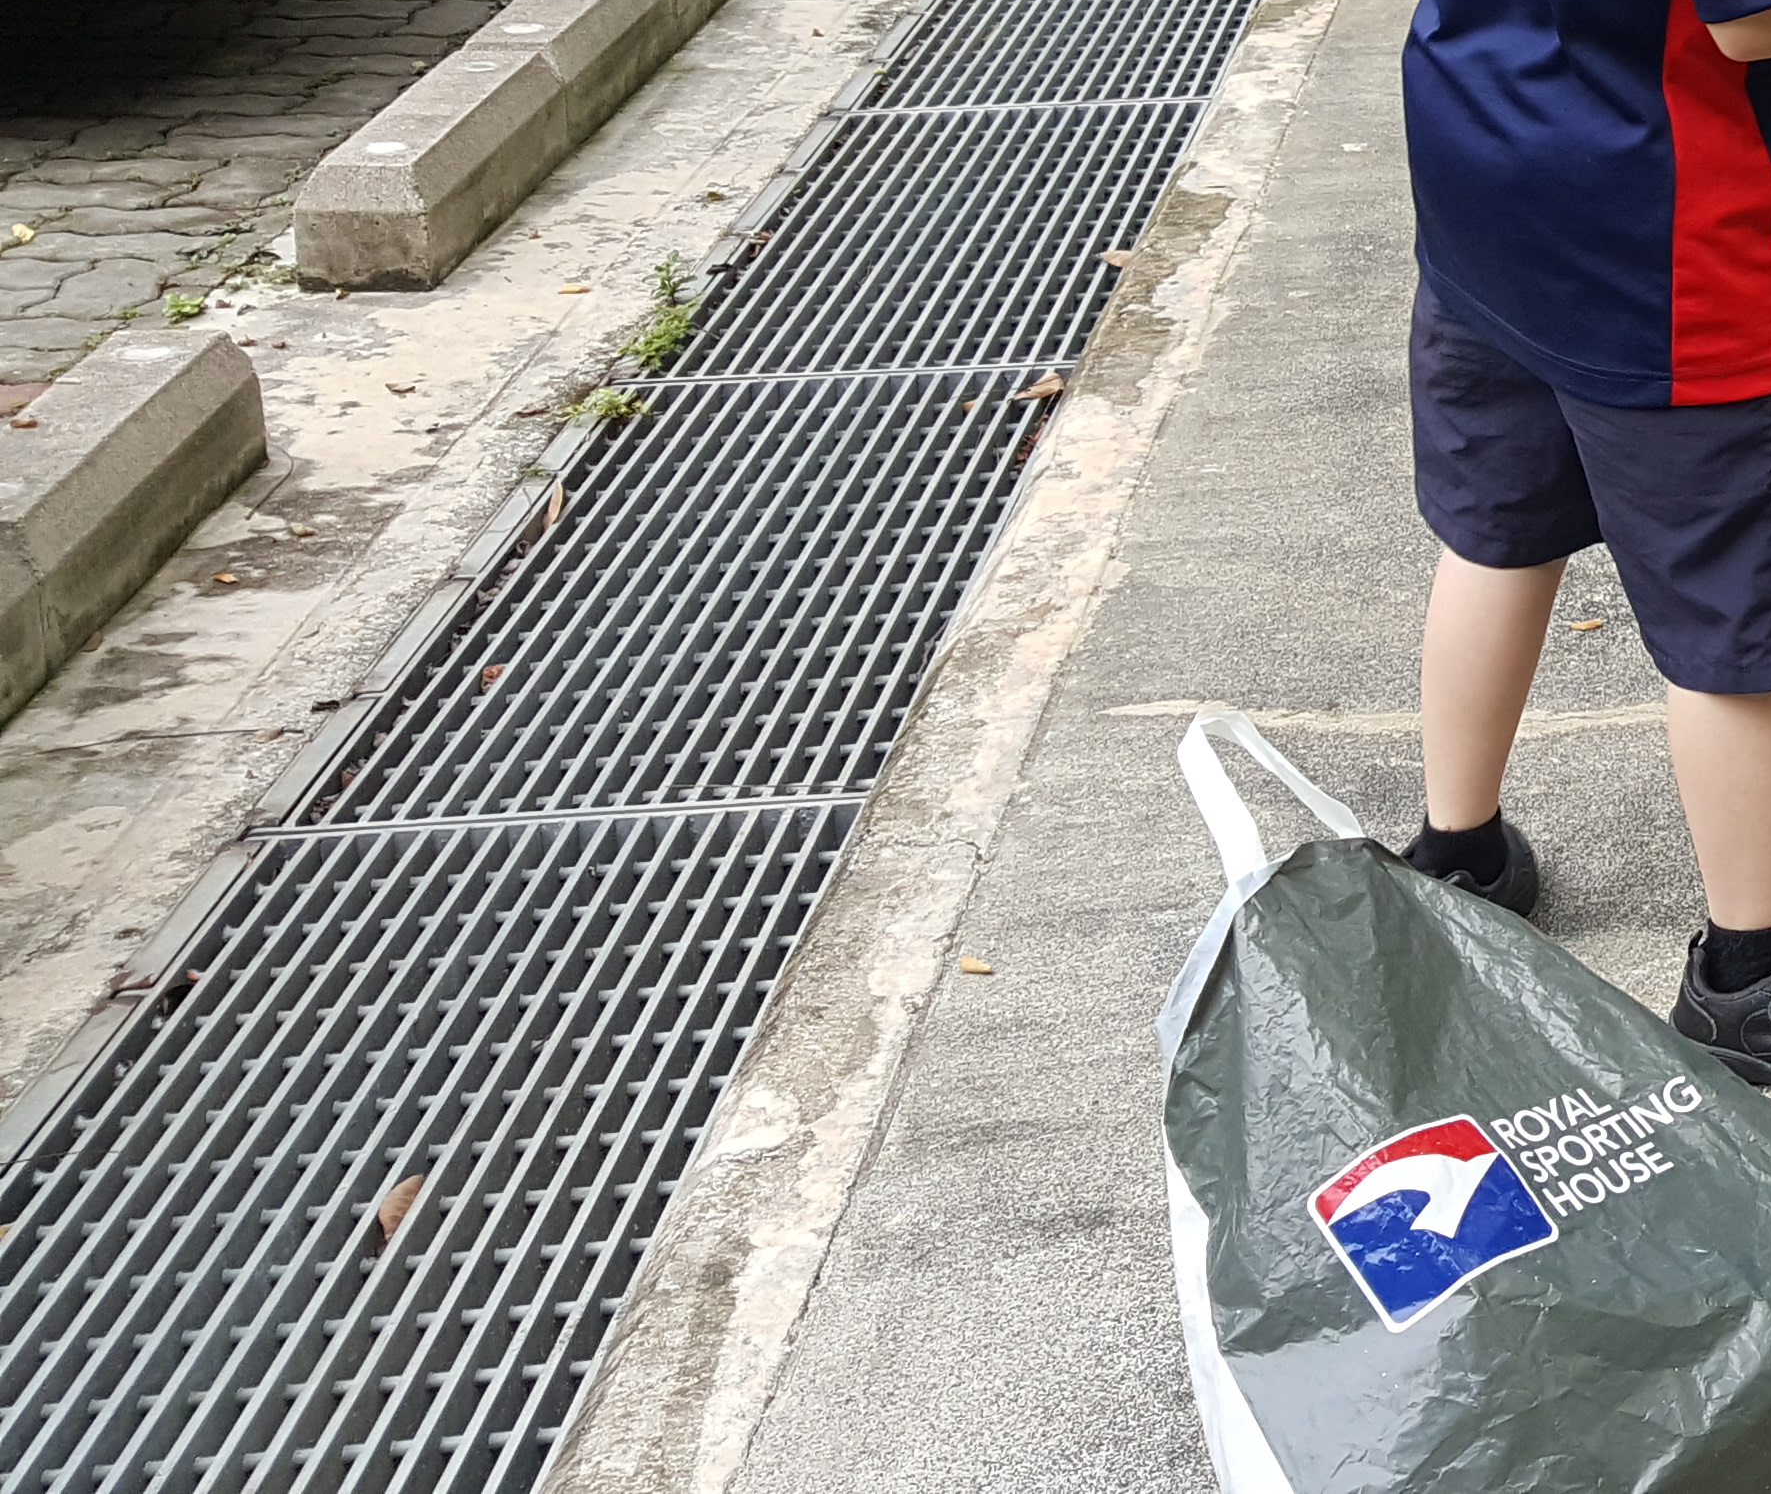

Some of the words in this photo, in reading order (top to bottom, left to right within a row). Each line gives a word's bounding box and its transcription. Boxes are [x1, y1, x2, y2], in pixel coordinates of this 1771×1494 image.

[1489, 1087, 1613, 1149] ROYAL
[1519, 1075, 1703, 1183] SPORTING
[1541, 1141, 1675, 1217] HOUSE
